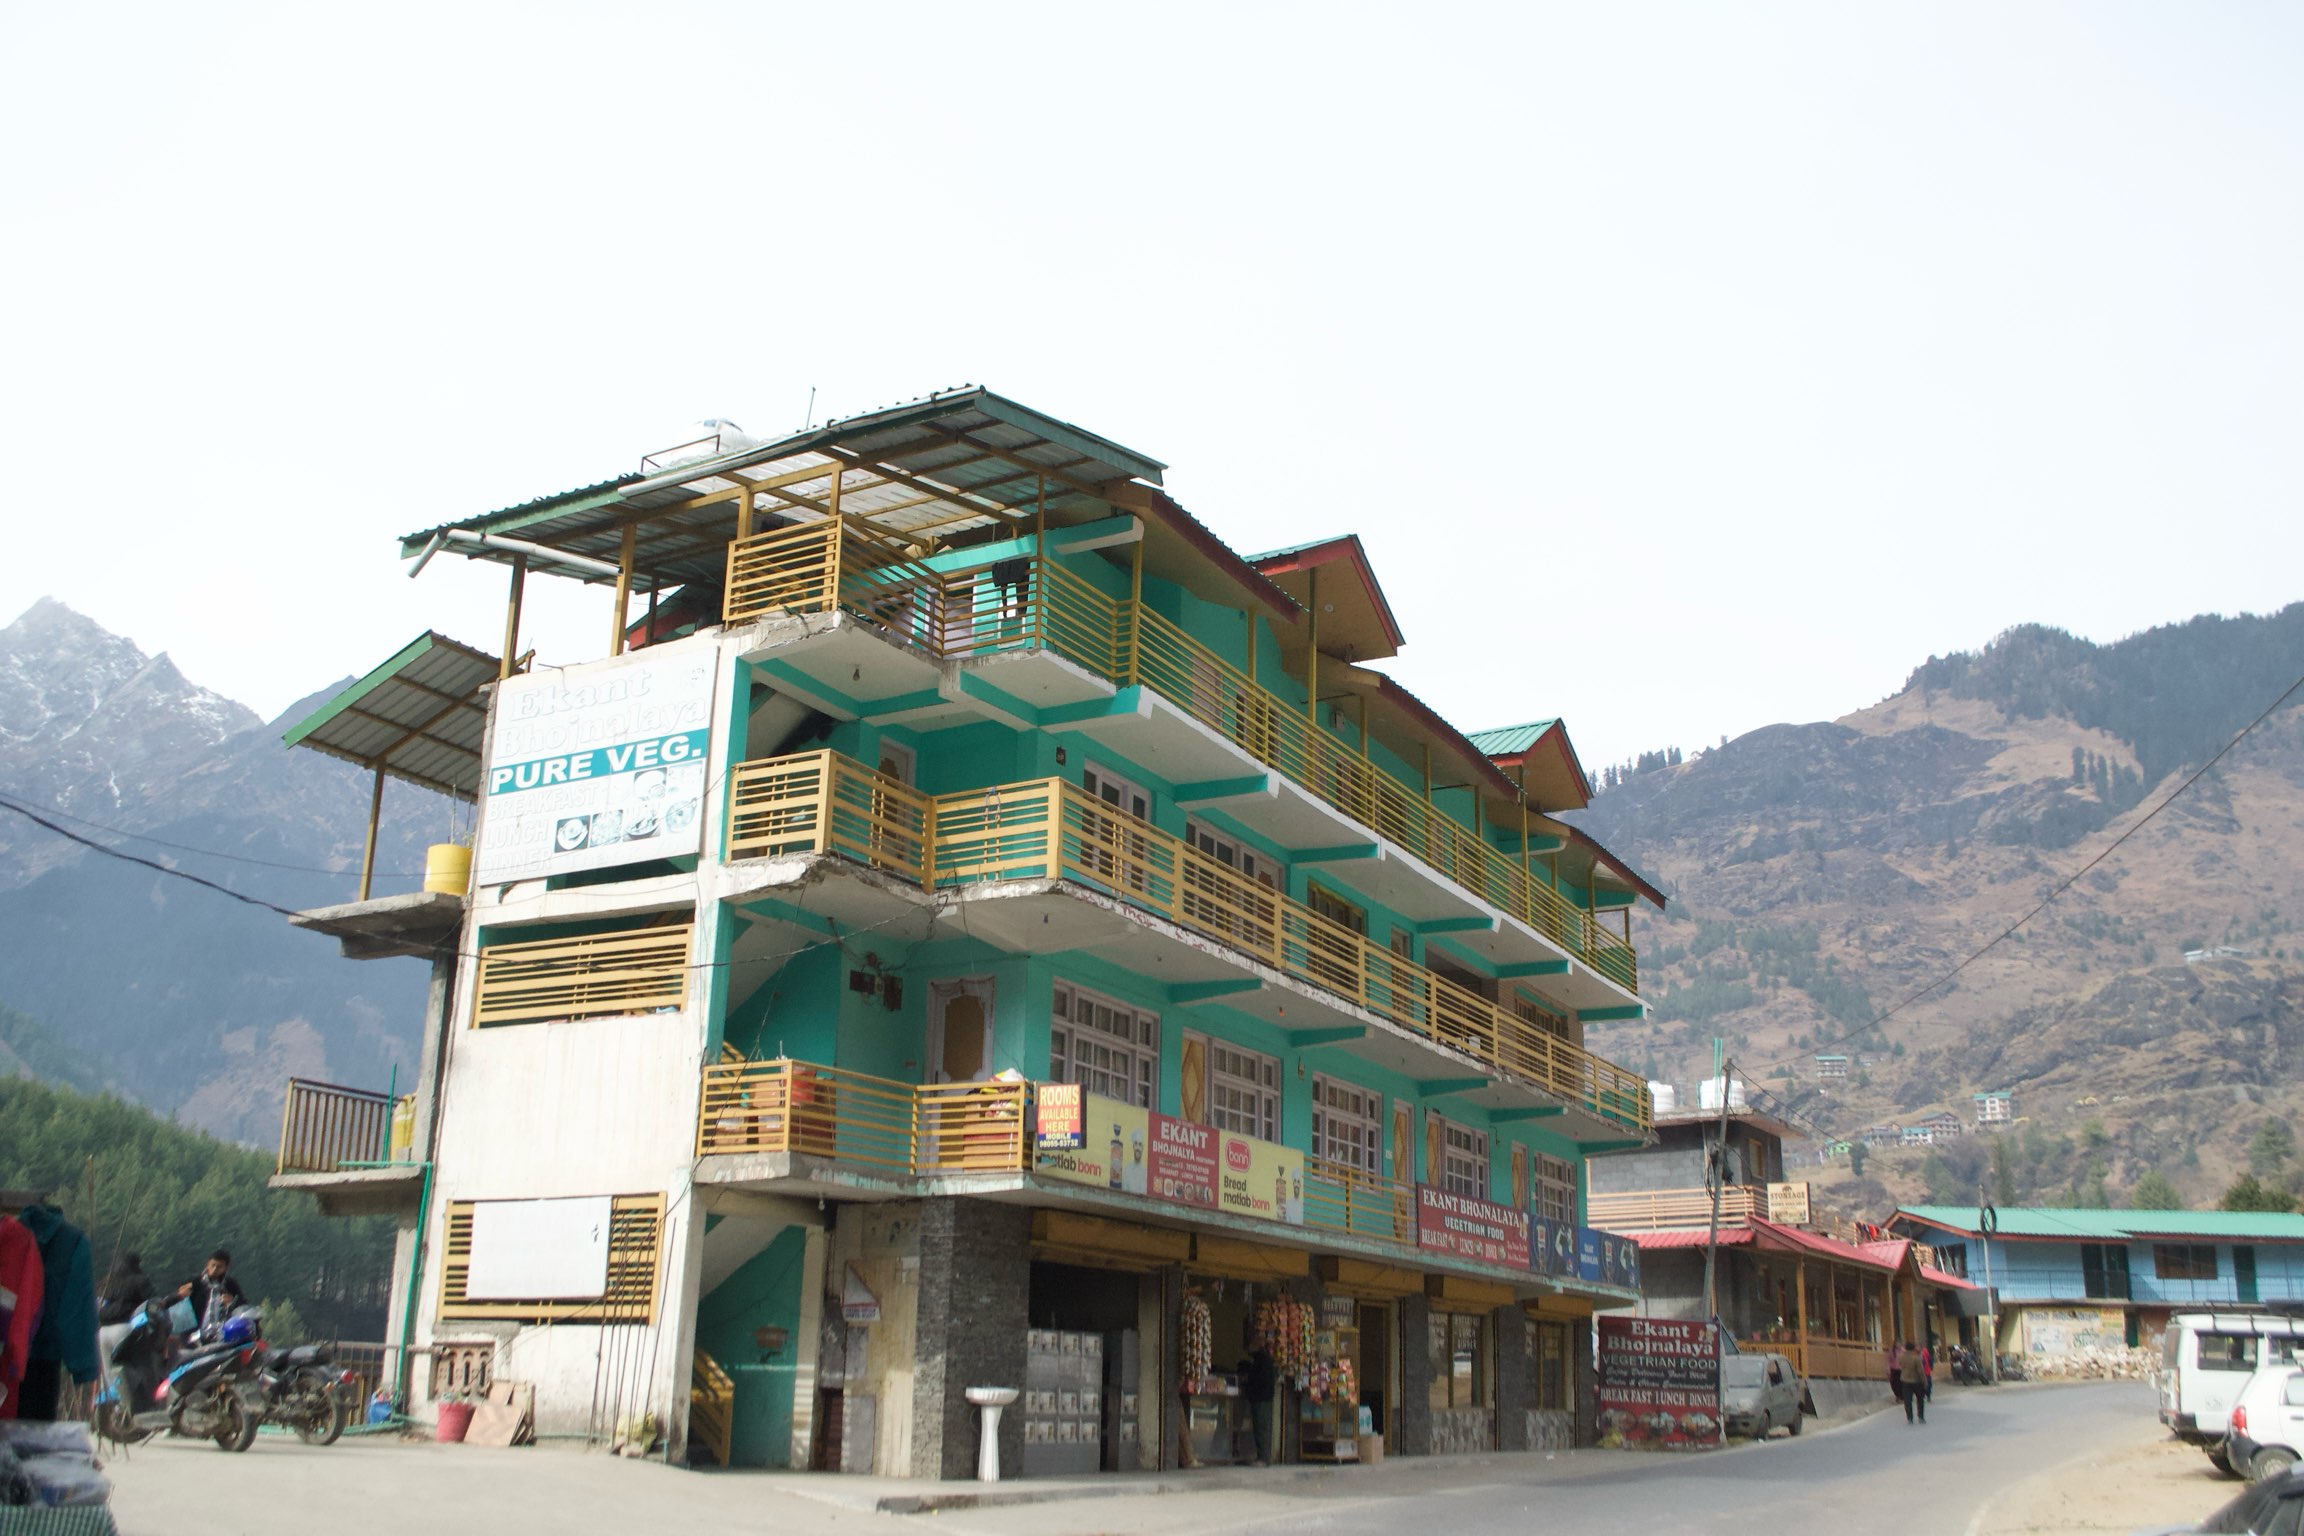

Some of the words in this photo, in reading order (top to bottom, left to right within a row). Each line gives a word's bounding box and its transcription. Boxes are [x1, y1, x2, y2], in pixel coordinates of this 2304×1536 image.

[510, 667, 652, 721] Ekant
[495, 697, 707, 759] Bhojnalaya
[490, 752, 594, 793] PURE
[605, 736, 702, 772] VEG.
[488, 782, 600, 822] BREAKFAST
[484, 818, 549, 849] LUNCH
[481, 848, 552, 880] DINNER
[1040, 1086, 1079, 1106] ROOMS
[1040, 1107, 1078, 1120] AVAILABLE
[1045, 1121, 1070, 1132] HERE
[1045, 1132, 1071, 1140] MOBILE
[1160, 1120, 1208, 1149] EKANT
[1152, 1140, 1195, 1161] BHOJNALYA
[1228, 1145, 1249, 1165] bonn
[1077, 1158, 1101, 1176] bonn
[1224, 1175, 1247, 1192] Bread
[1224, 1192, 1251, 1208] matlab
[1252, 1195, 1270, 1211] bonn
[1770, 1191, 1805, 1200] STONEAGE
[1423, 1188, 1458, 1212] EKANT
[1460, 1199, 1520, 1228] BHOJNALAYA
[1444, 1216, 1486, 1237] VEGETRIAN
[1487, 1226, 1504, 1241] FOOD
[1631, 1320, 1690, 1338] Ekant
[1607, 1336, 1713, 1357] Bhojnalaya
[1602, 1353, 1676, 1368] VEGETRIAN
[1680, 1358, 1717, 1370] FOOD
[1655, 1391, 1685, 1406] LUNCH
[1689, 1393, 1717, 1408] DINNER
